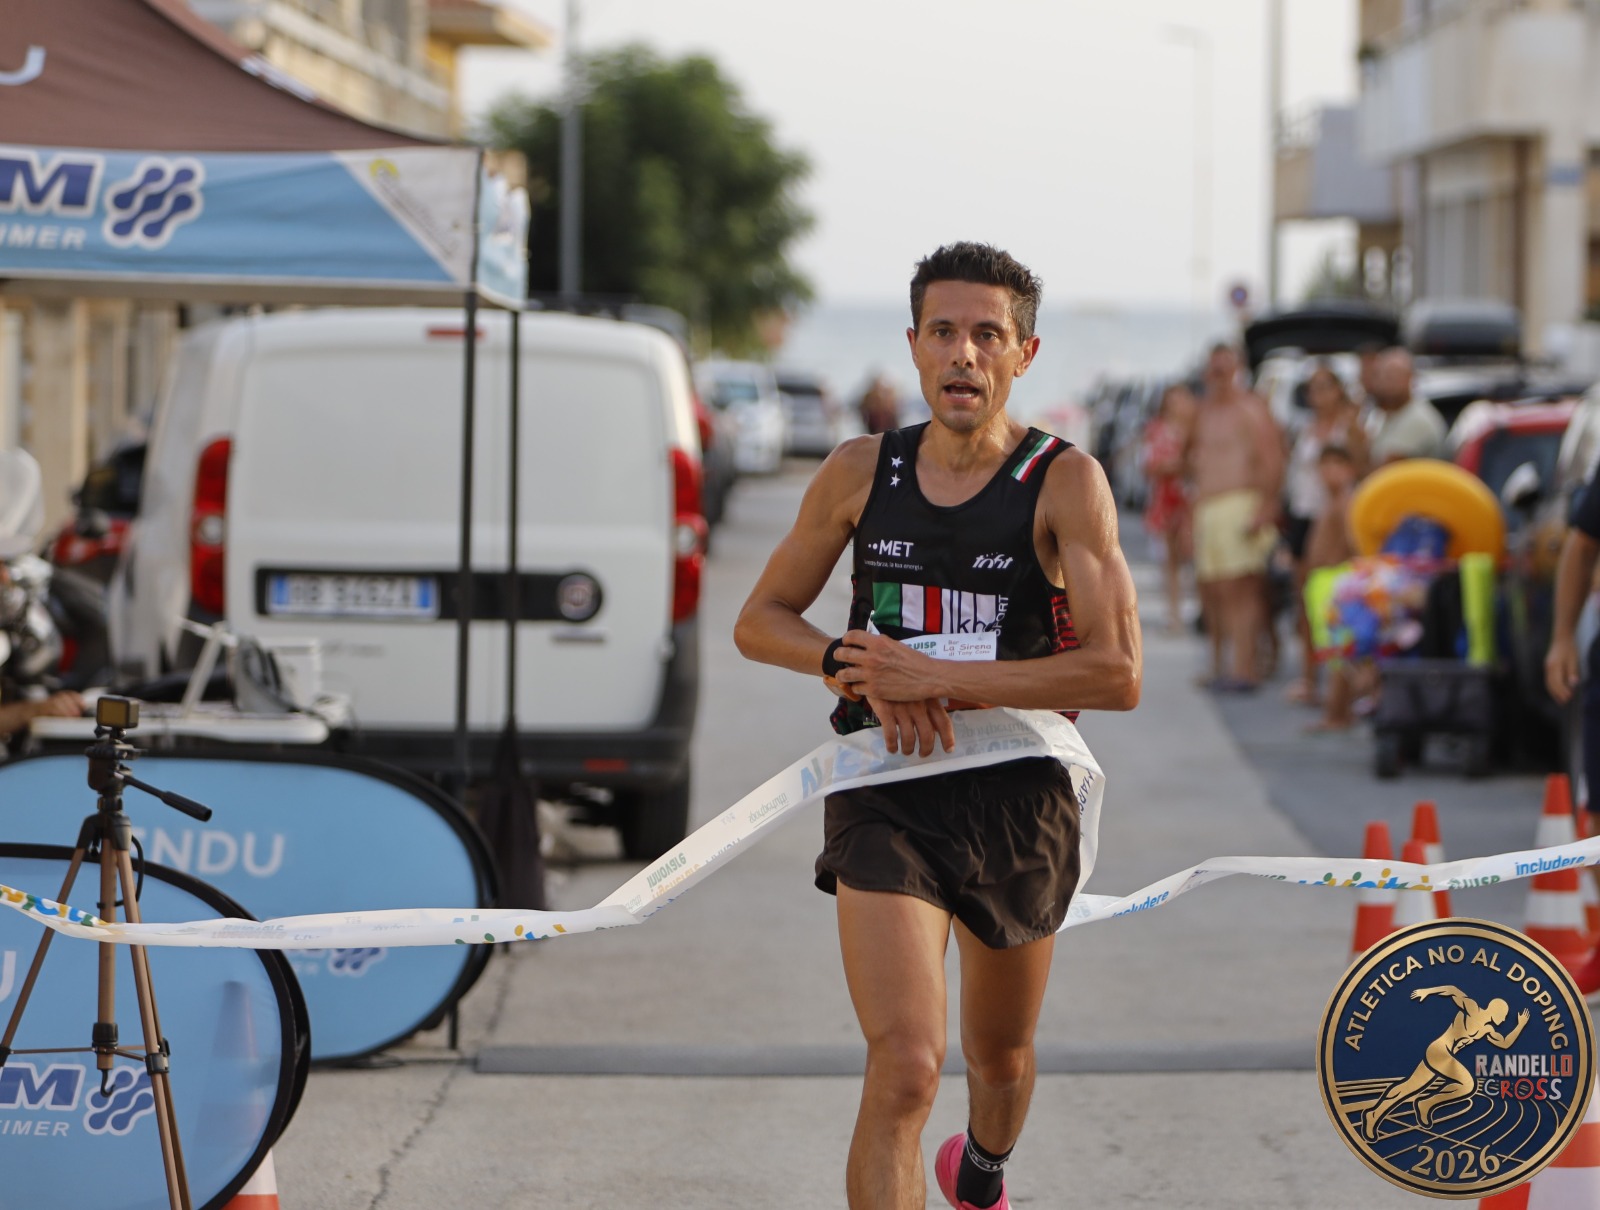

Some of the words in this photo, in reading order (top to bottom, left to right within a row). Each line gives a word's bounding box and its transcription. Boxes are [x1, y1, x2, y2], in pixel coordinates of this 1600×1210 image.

[879, 539, 914, 557] MET
[996, 594, 1009, 637] SPORT
[913, 641, 937, 650] UISP
[943, 644, 955, 652] La
[960, 643, 992, 651] Sirena
[1515, 855, 1586, 876] includere
[0, 1120, 70, 1137] IMER
